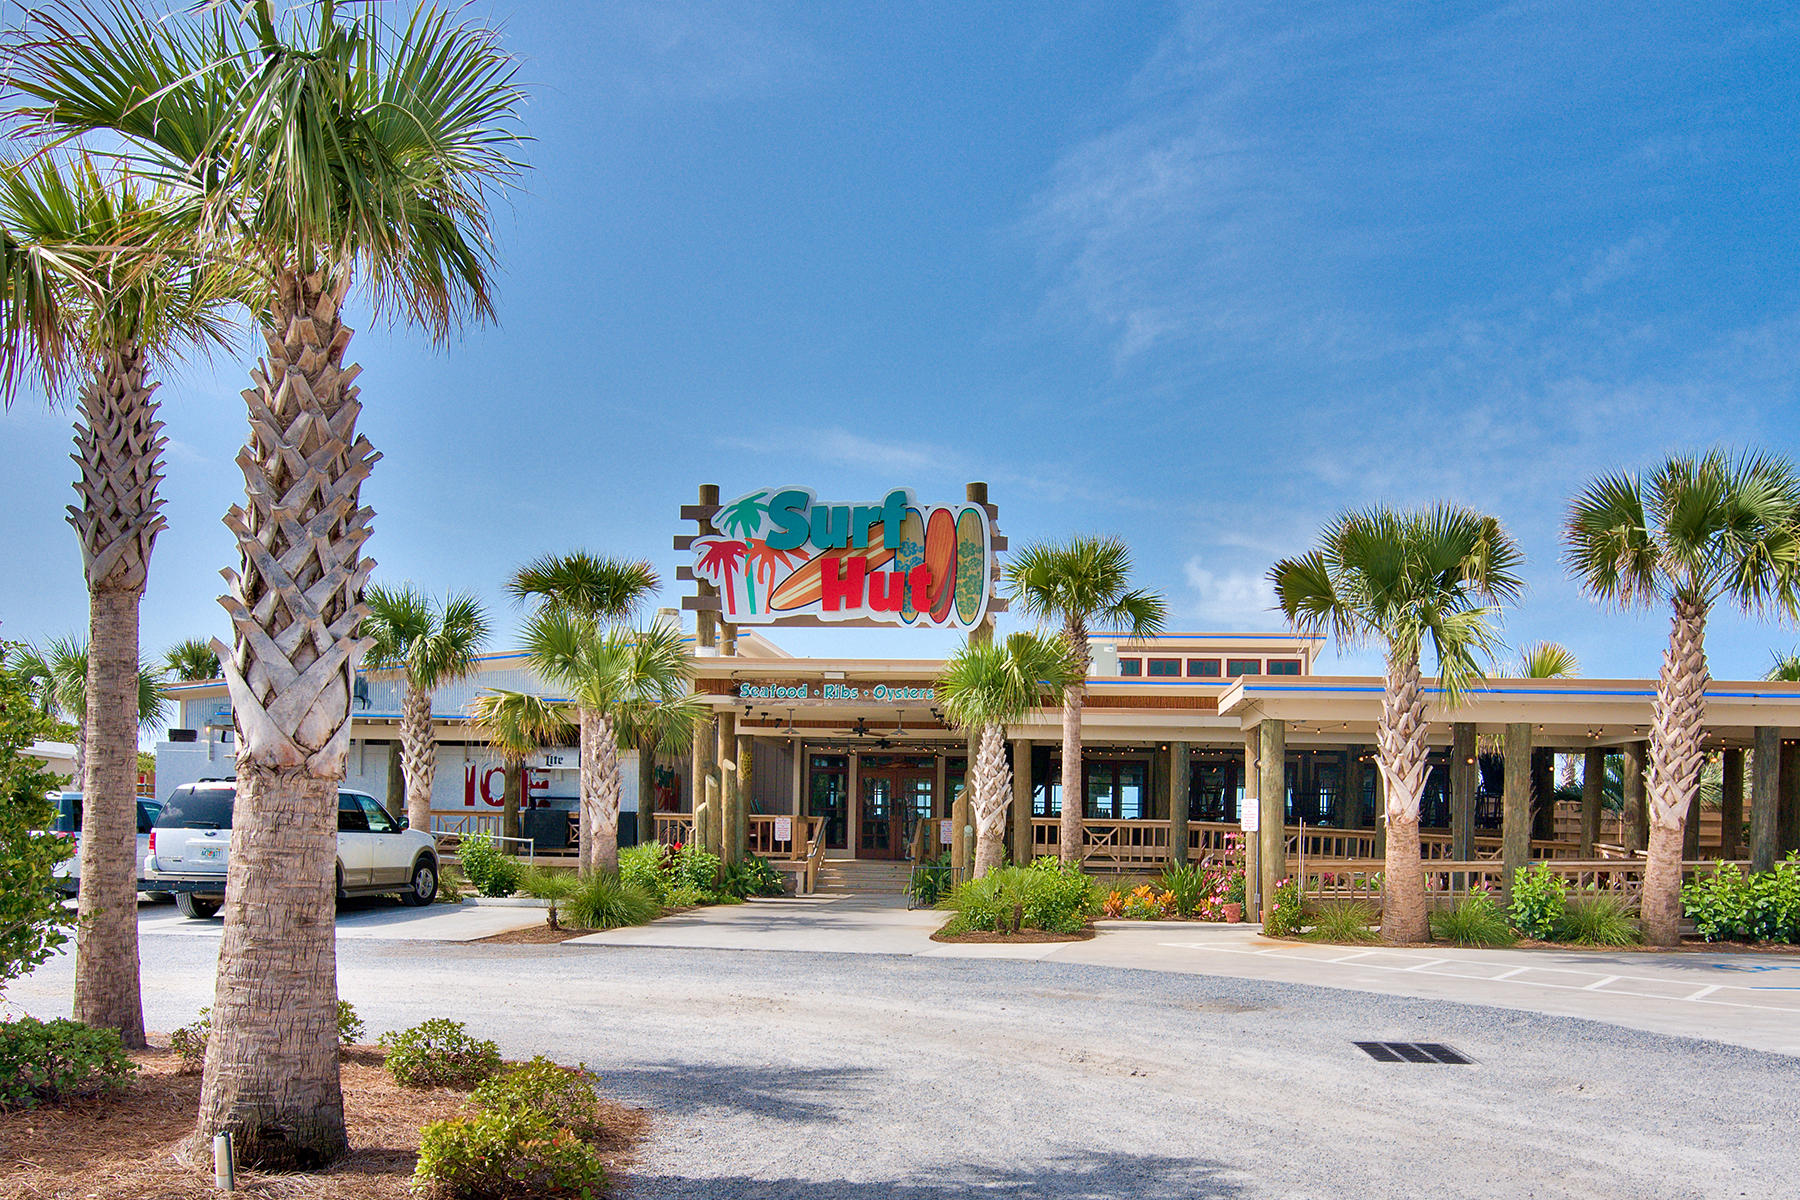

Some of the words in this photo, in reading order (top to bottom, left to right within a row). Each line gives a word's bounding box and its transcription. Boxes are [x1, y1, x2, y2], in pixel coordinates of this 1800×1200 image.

[765, 490, 908, 550] Surf
[820, 556, 933, 613] Hut
[740, 682, 808, 698] Seafood
[823, 684, 859, 699] Ribs
[873, 684, 935, 702] Oysters
[545, 755, 564, 767] Lite
